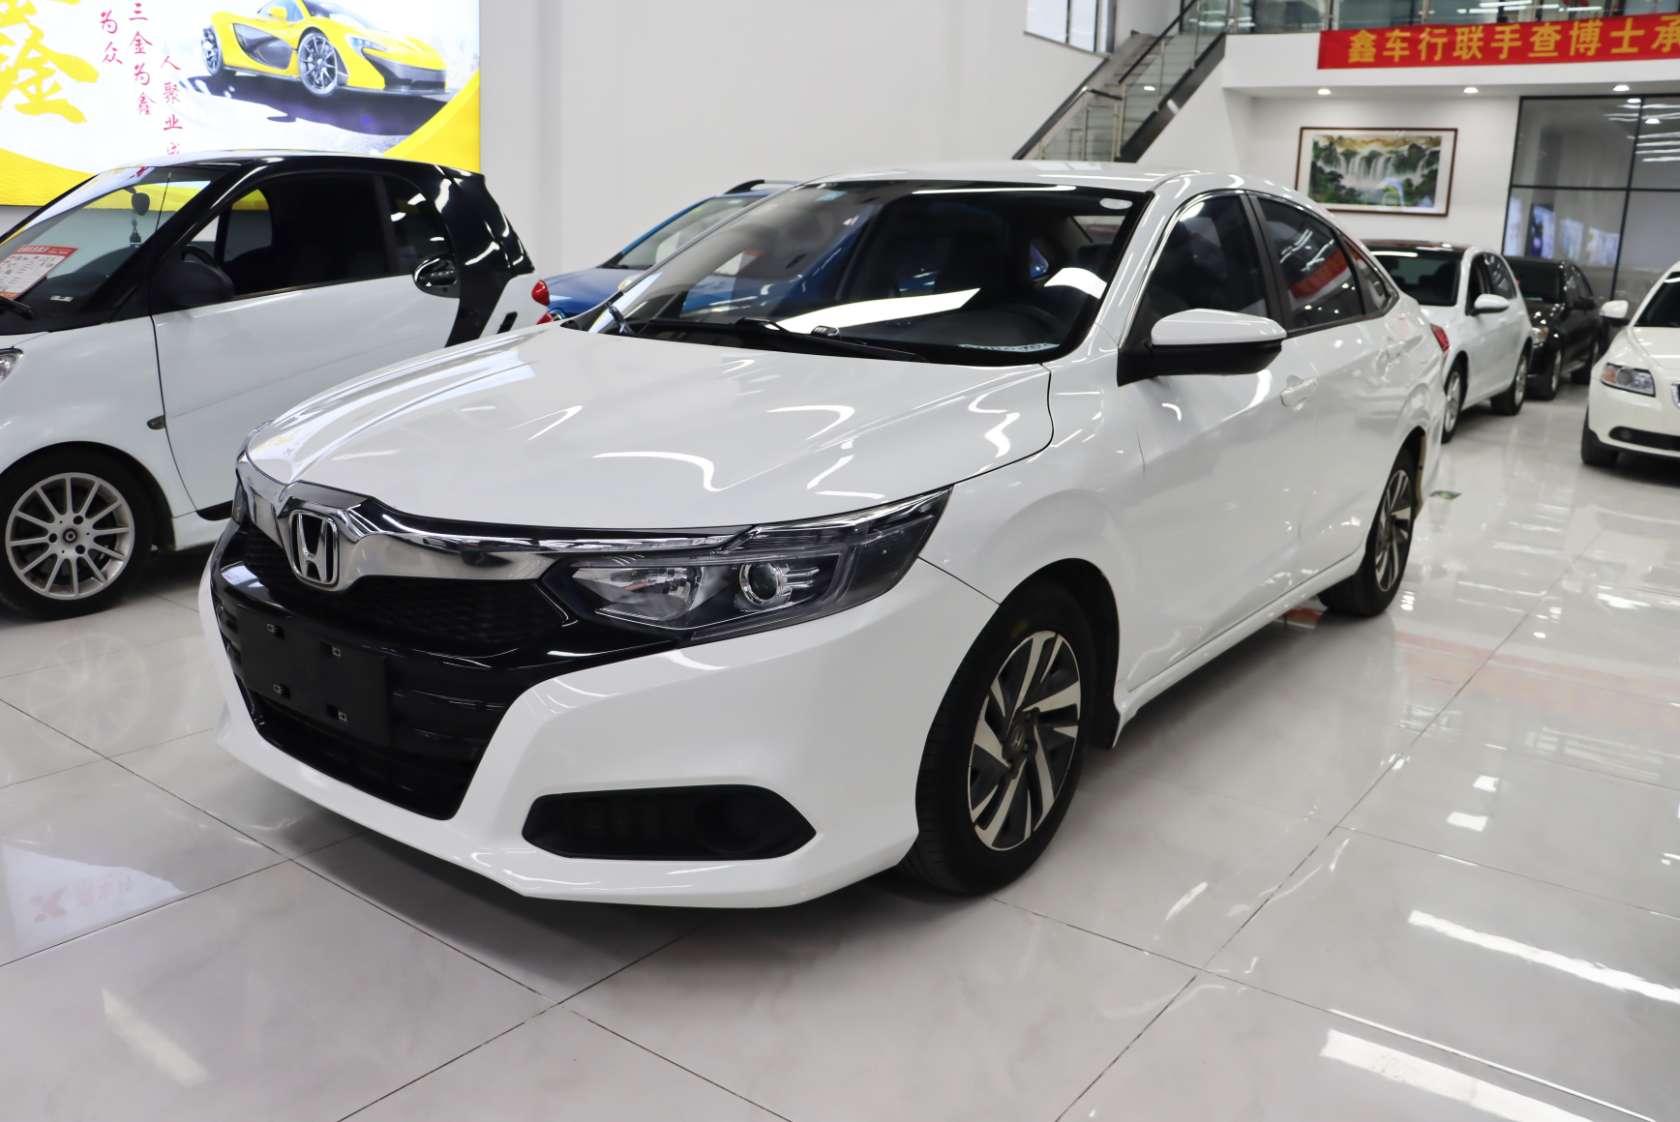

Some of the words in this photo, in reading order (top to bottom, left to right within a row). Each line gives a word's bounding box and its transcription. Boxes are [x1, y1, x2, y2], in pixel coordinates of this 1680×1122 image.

[1348, 14, 1680, 64] 鑫车行联手查博士承
